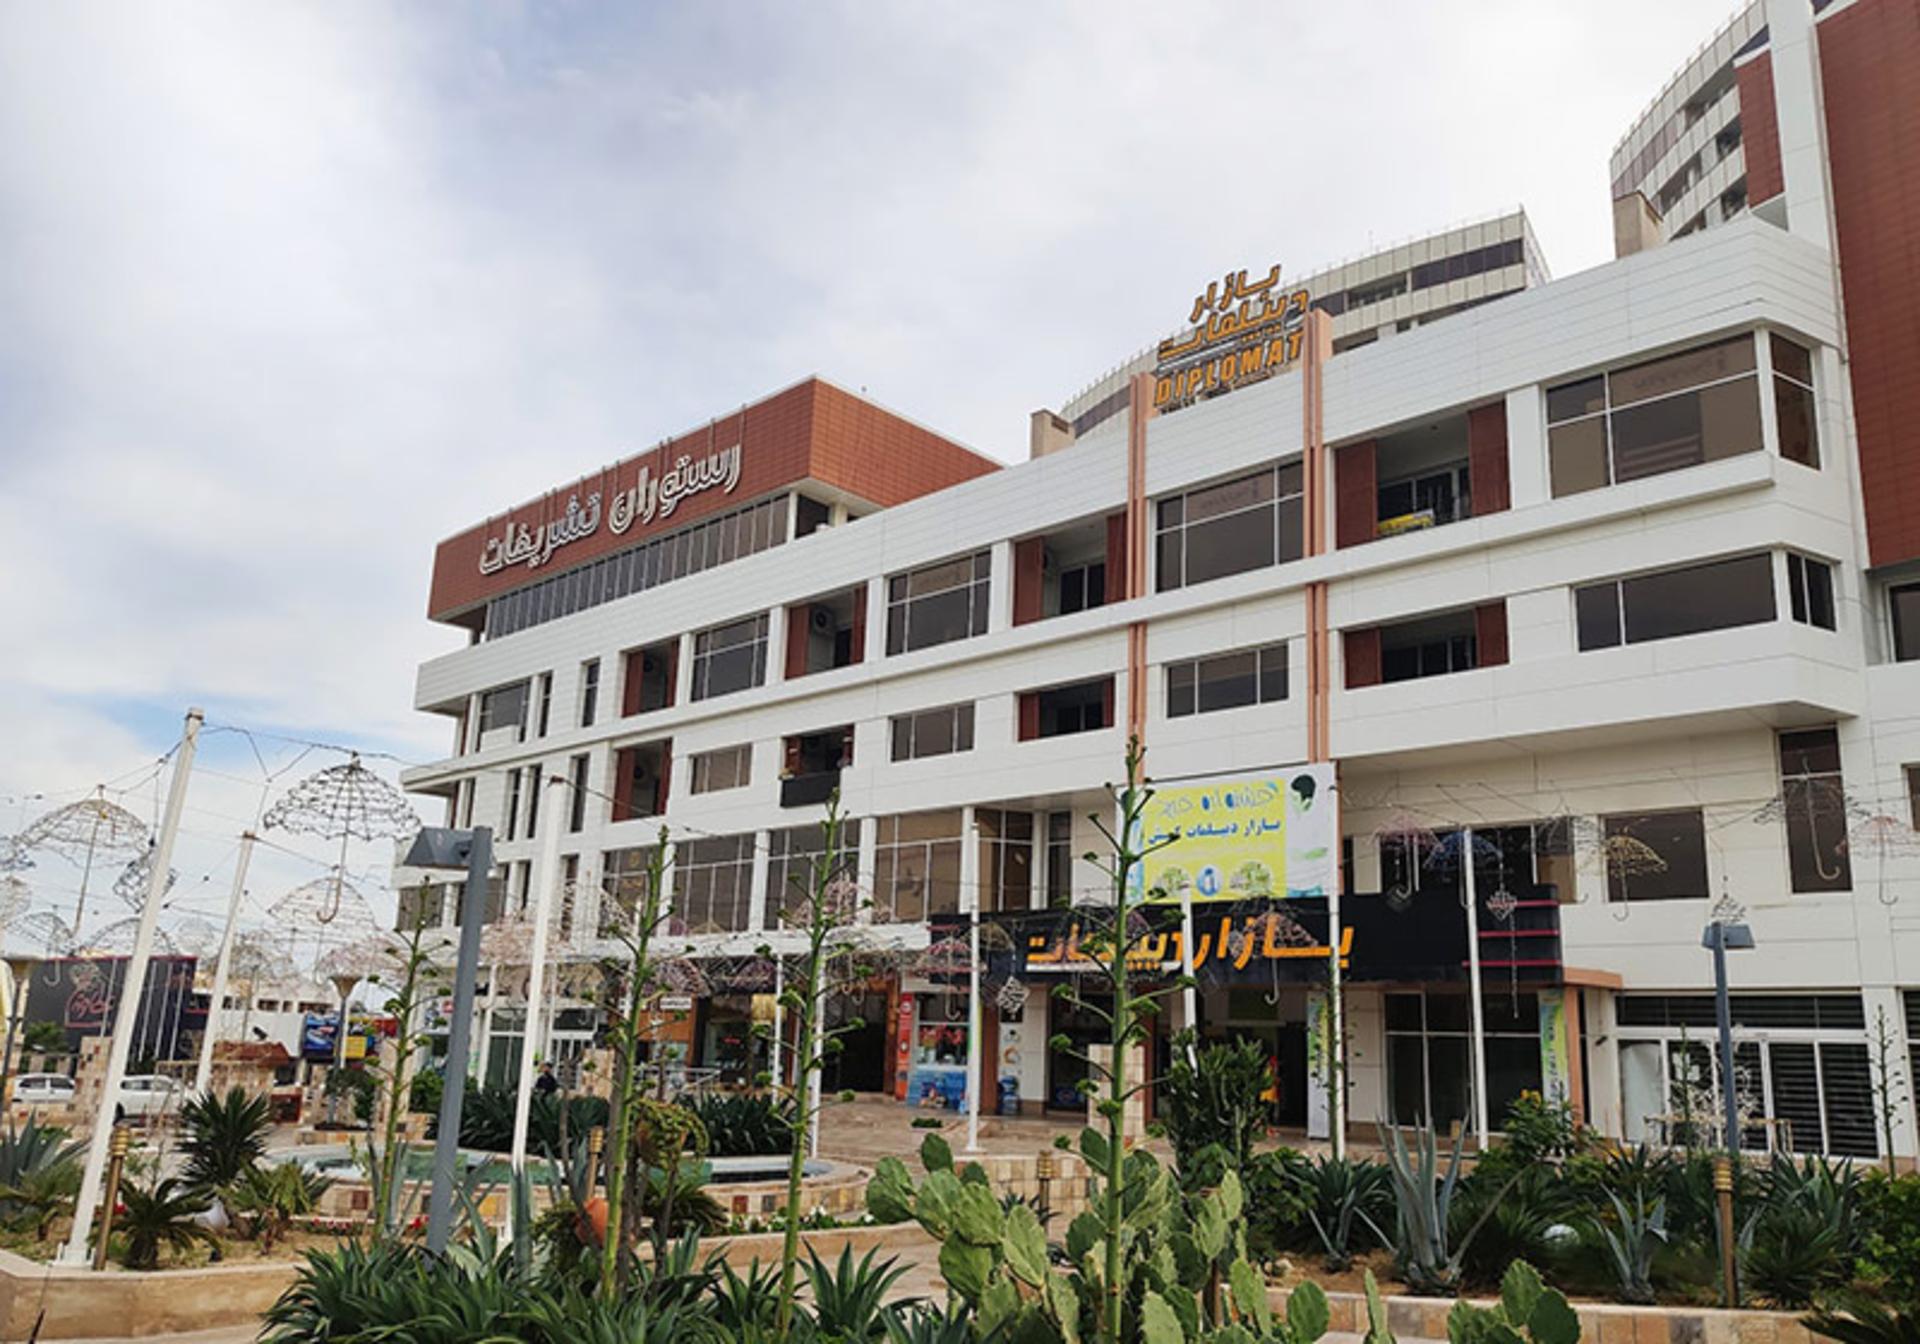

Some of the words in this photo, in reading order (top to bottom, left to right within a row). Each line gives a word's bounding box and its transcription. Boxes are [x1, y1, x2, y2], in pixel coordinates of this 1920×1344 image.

[1189, 264, 1281, 323] بازار
[1153, 327, 1305, 407] DIPLOMAT
[608, 444, 742, 535] رستوران
[478, 492, 602, 576] تشریفات
[1192, 916, 1355, 971] بازار
